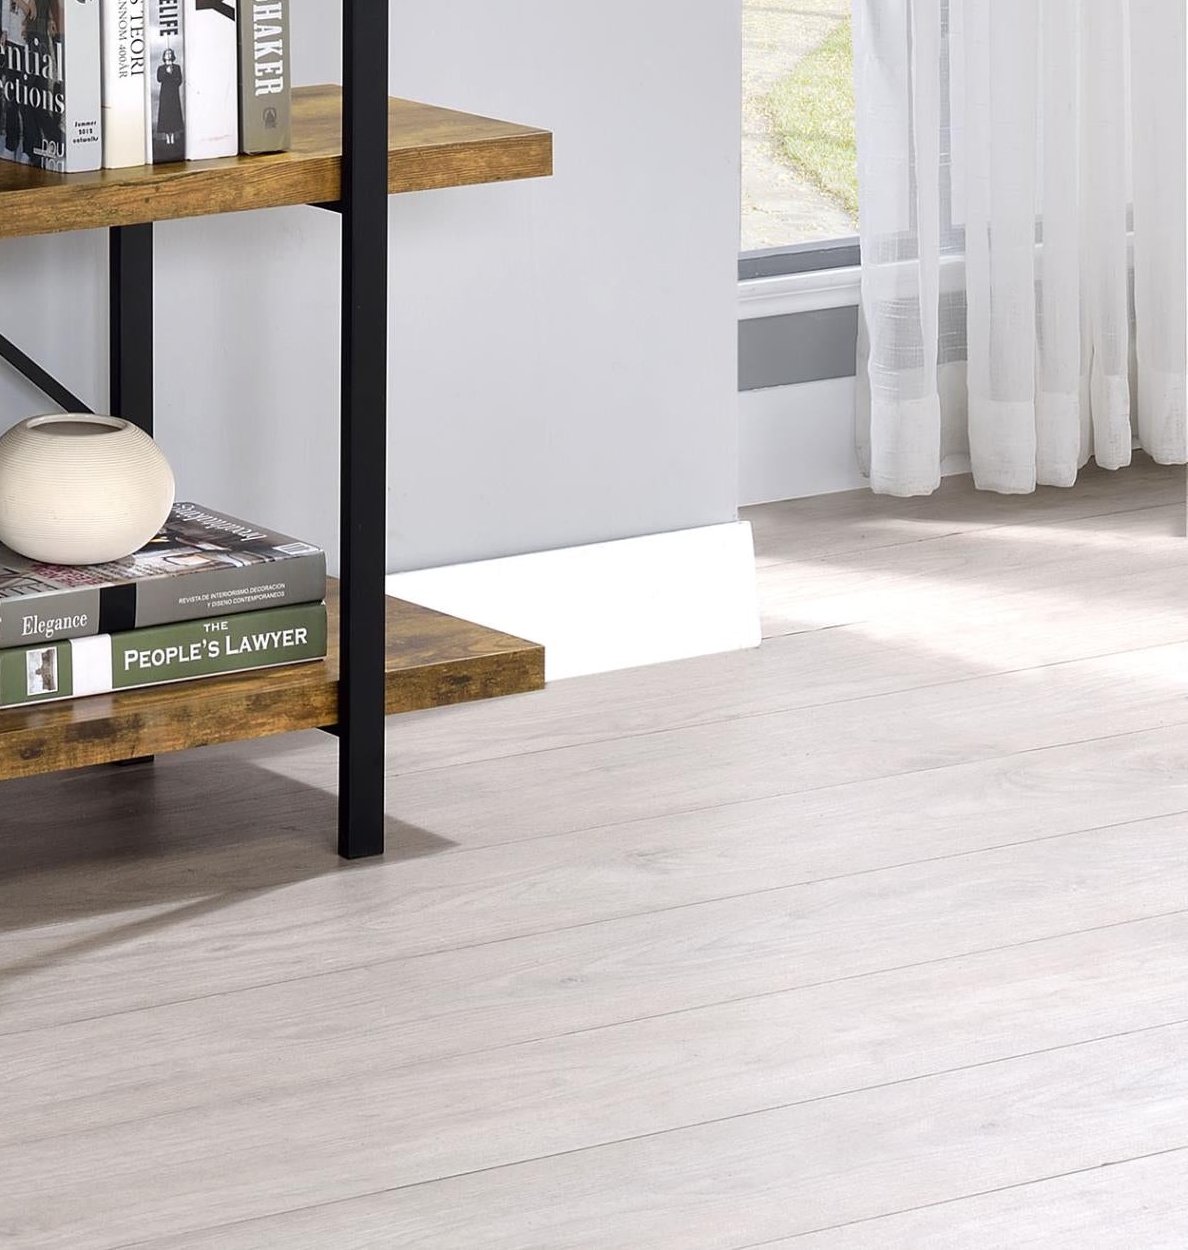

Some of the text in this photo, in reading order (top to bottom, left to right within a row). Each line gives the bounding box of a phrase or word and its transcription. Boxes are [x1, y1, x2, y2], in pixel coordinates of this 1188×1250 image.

[129, 10, 145, 76] TEORI
[21, 614, 88, 638] Elegance
[203, 621, 229, 633] THE
[225, 627, 308, 656] LAWYER
